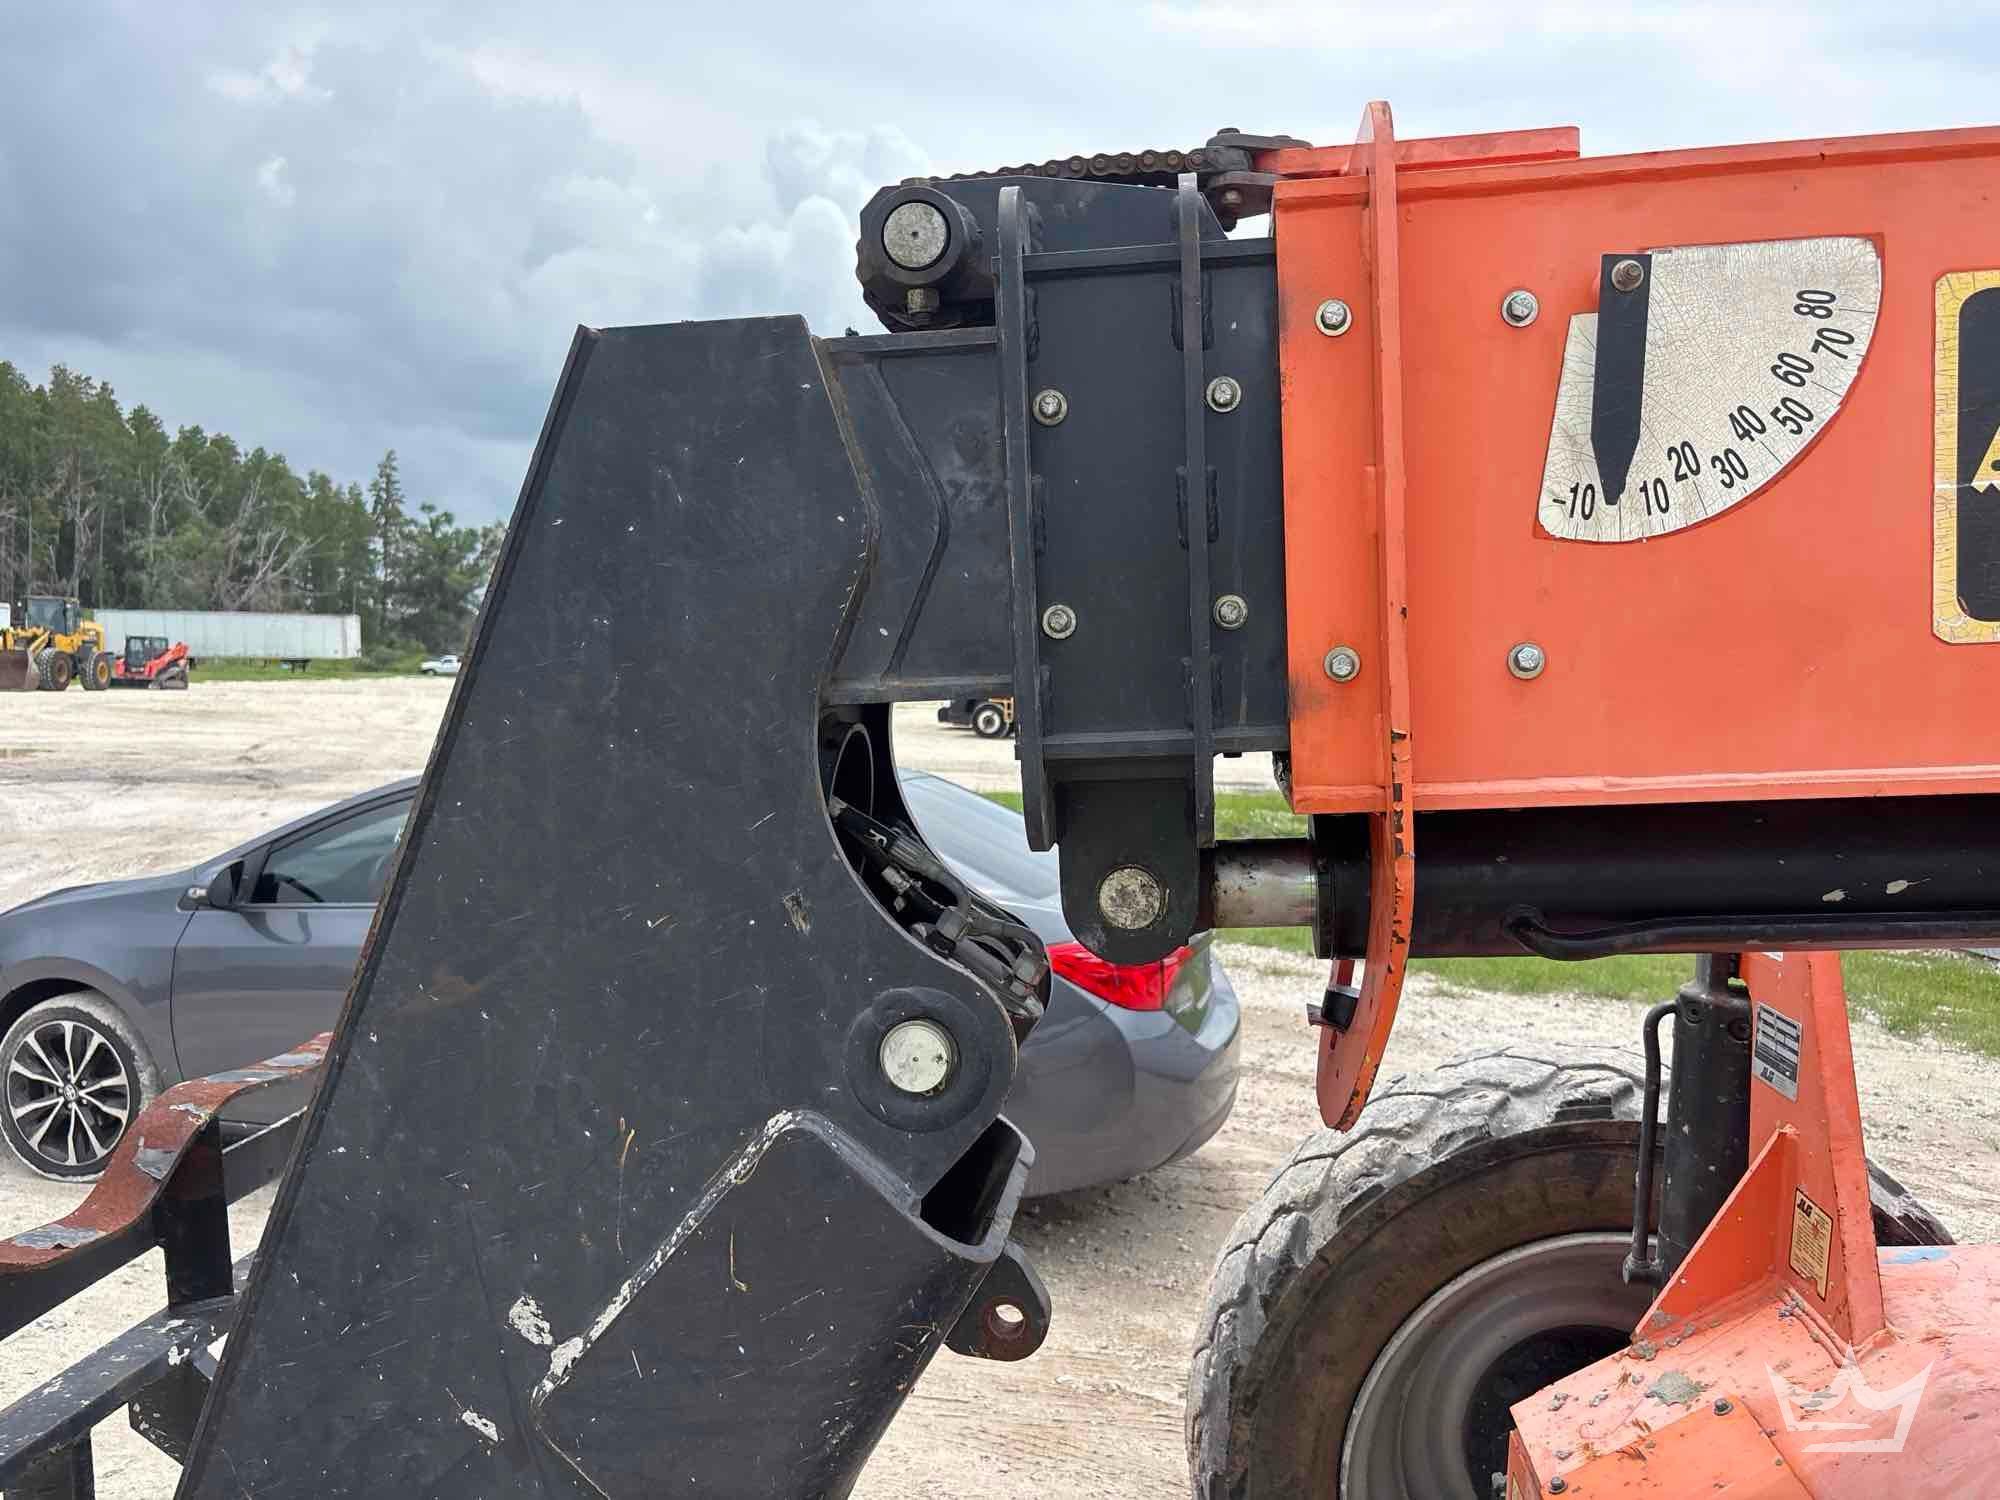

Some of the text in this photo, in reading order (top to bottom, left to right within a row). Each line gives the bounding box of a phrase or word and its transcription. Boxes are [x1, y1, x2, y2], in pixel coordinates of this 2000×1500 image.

[1794, 289, 1836, 319] 80
[1812, 327, 1855, 360] 70
[1771, 352, 1814, 387] 60
[1728, 404, 1767, 443] 40
[1771, 396, 1814, 436] 50
[1667, 440, 1701, 482] 20
[1711, 448, 1749, 489] 30
[1552, 482, 1595, 520] -10
[1639, 477, 1670, 516] 10
[1797, 1198, 1813, 1217] JLG
